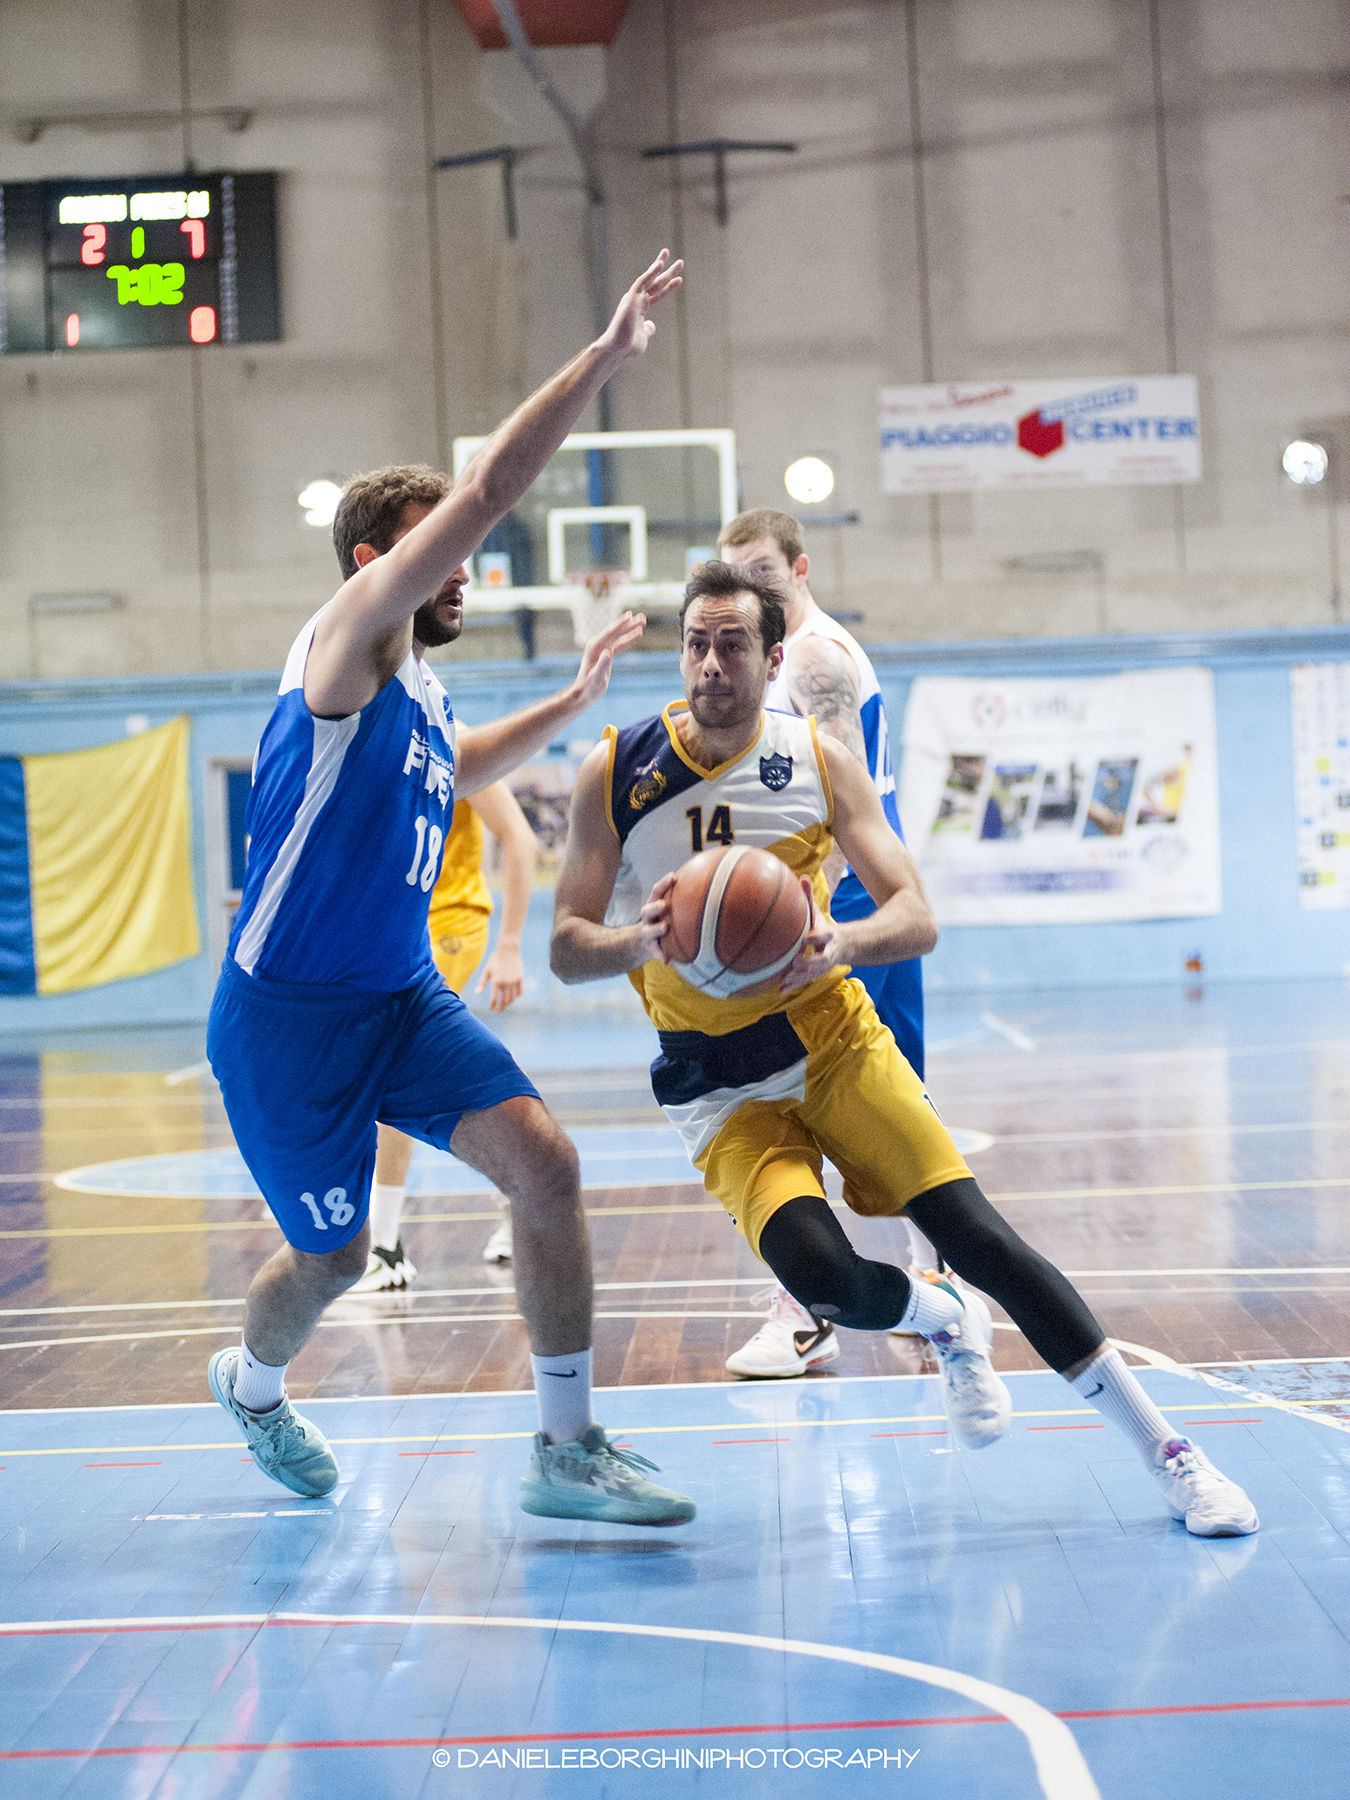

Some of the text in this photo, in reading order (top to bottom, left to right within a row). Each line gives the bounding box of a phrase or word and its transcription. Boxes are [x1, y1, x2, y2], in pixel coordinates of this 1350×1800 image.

[82, 223, 107, 265] 2
[131, 226, 145, 259] 1
[180, 219, 206, 260] 7
[106, 263, 186, 306] 7:02
[66, 313, 80, 347] 1
[881, 415, 1198, 449] PIAGGIO CENTER
[686, 803, 734, 853] 14
[405, 815, 443, 893] 18
[299, 1186, 356, 1231] 18
